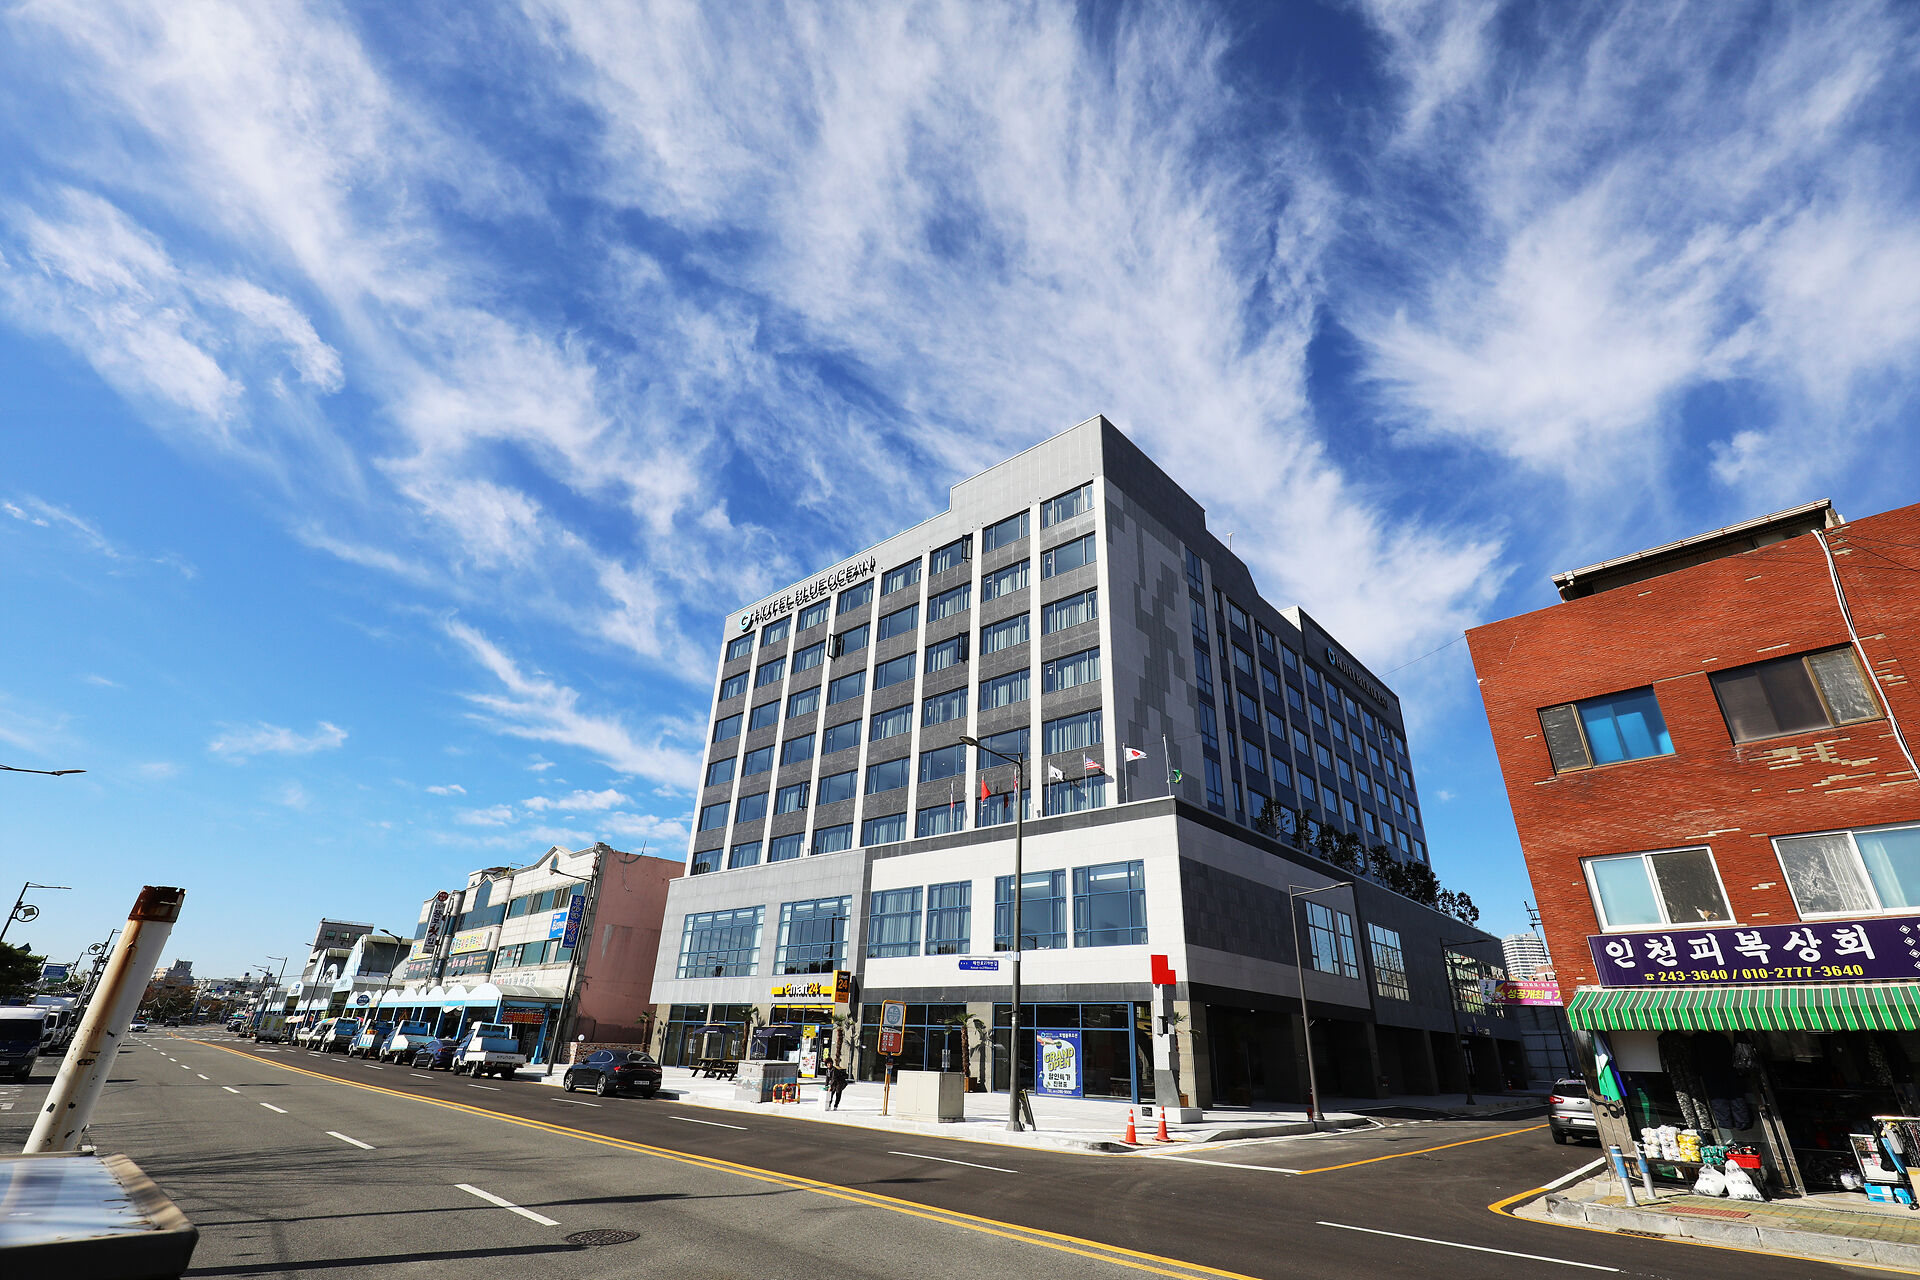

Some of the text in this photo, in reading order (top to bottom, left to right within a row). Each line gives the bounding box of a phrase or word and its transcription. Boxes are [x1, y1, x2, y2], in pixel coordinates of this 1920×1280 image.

[1605, 924, 1876, 968] 인천피복상회
[1658, 969, 1728, 981] 243-3640
[1742, 964, 1864, 979] 010-2777-3640
[1044, 1047, 1074, 1063] GRAND
[1048, 1057, 1071, 1071] OPEN
